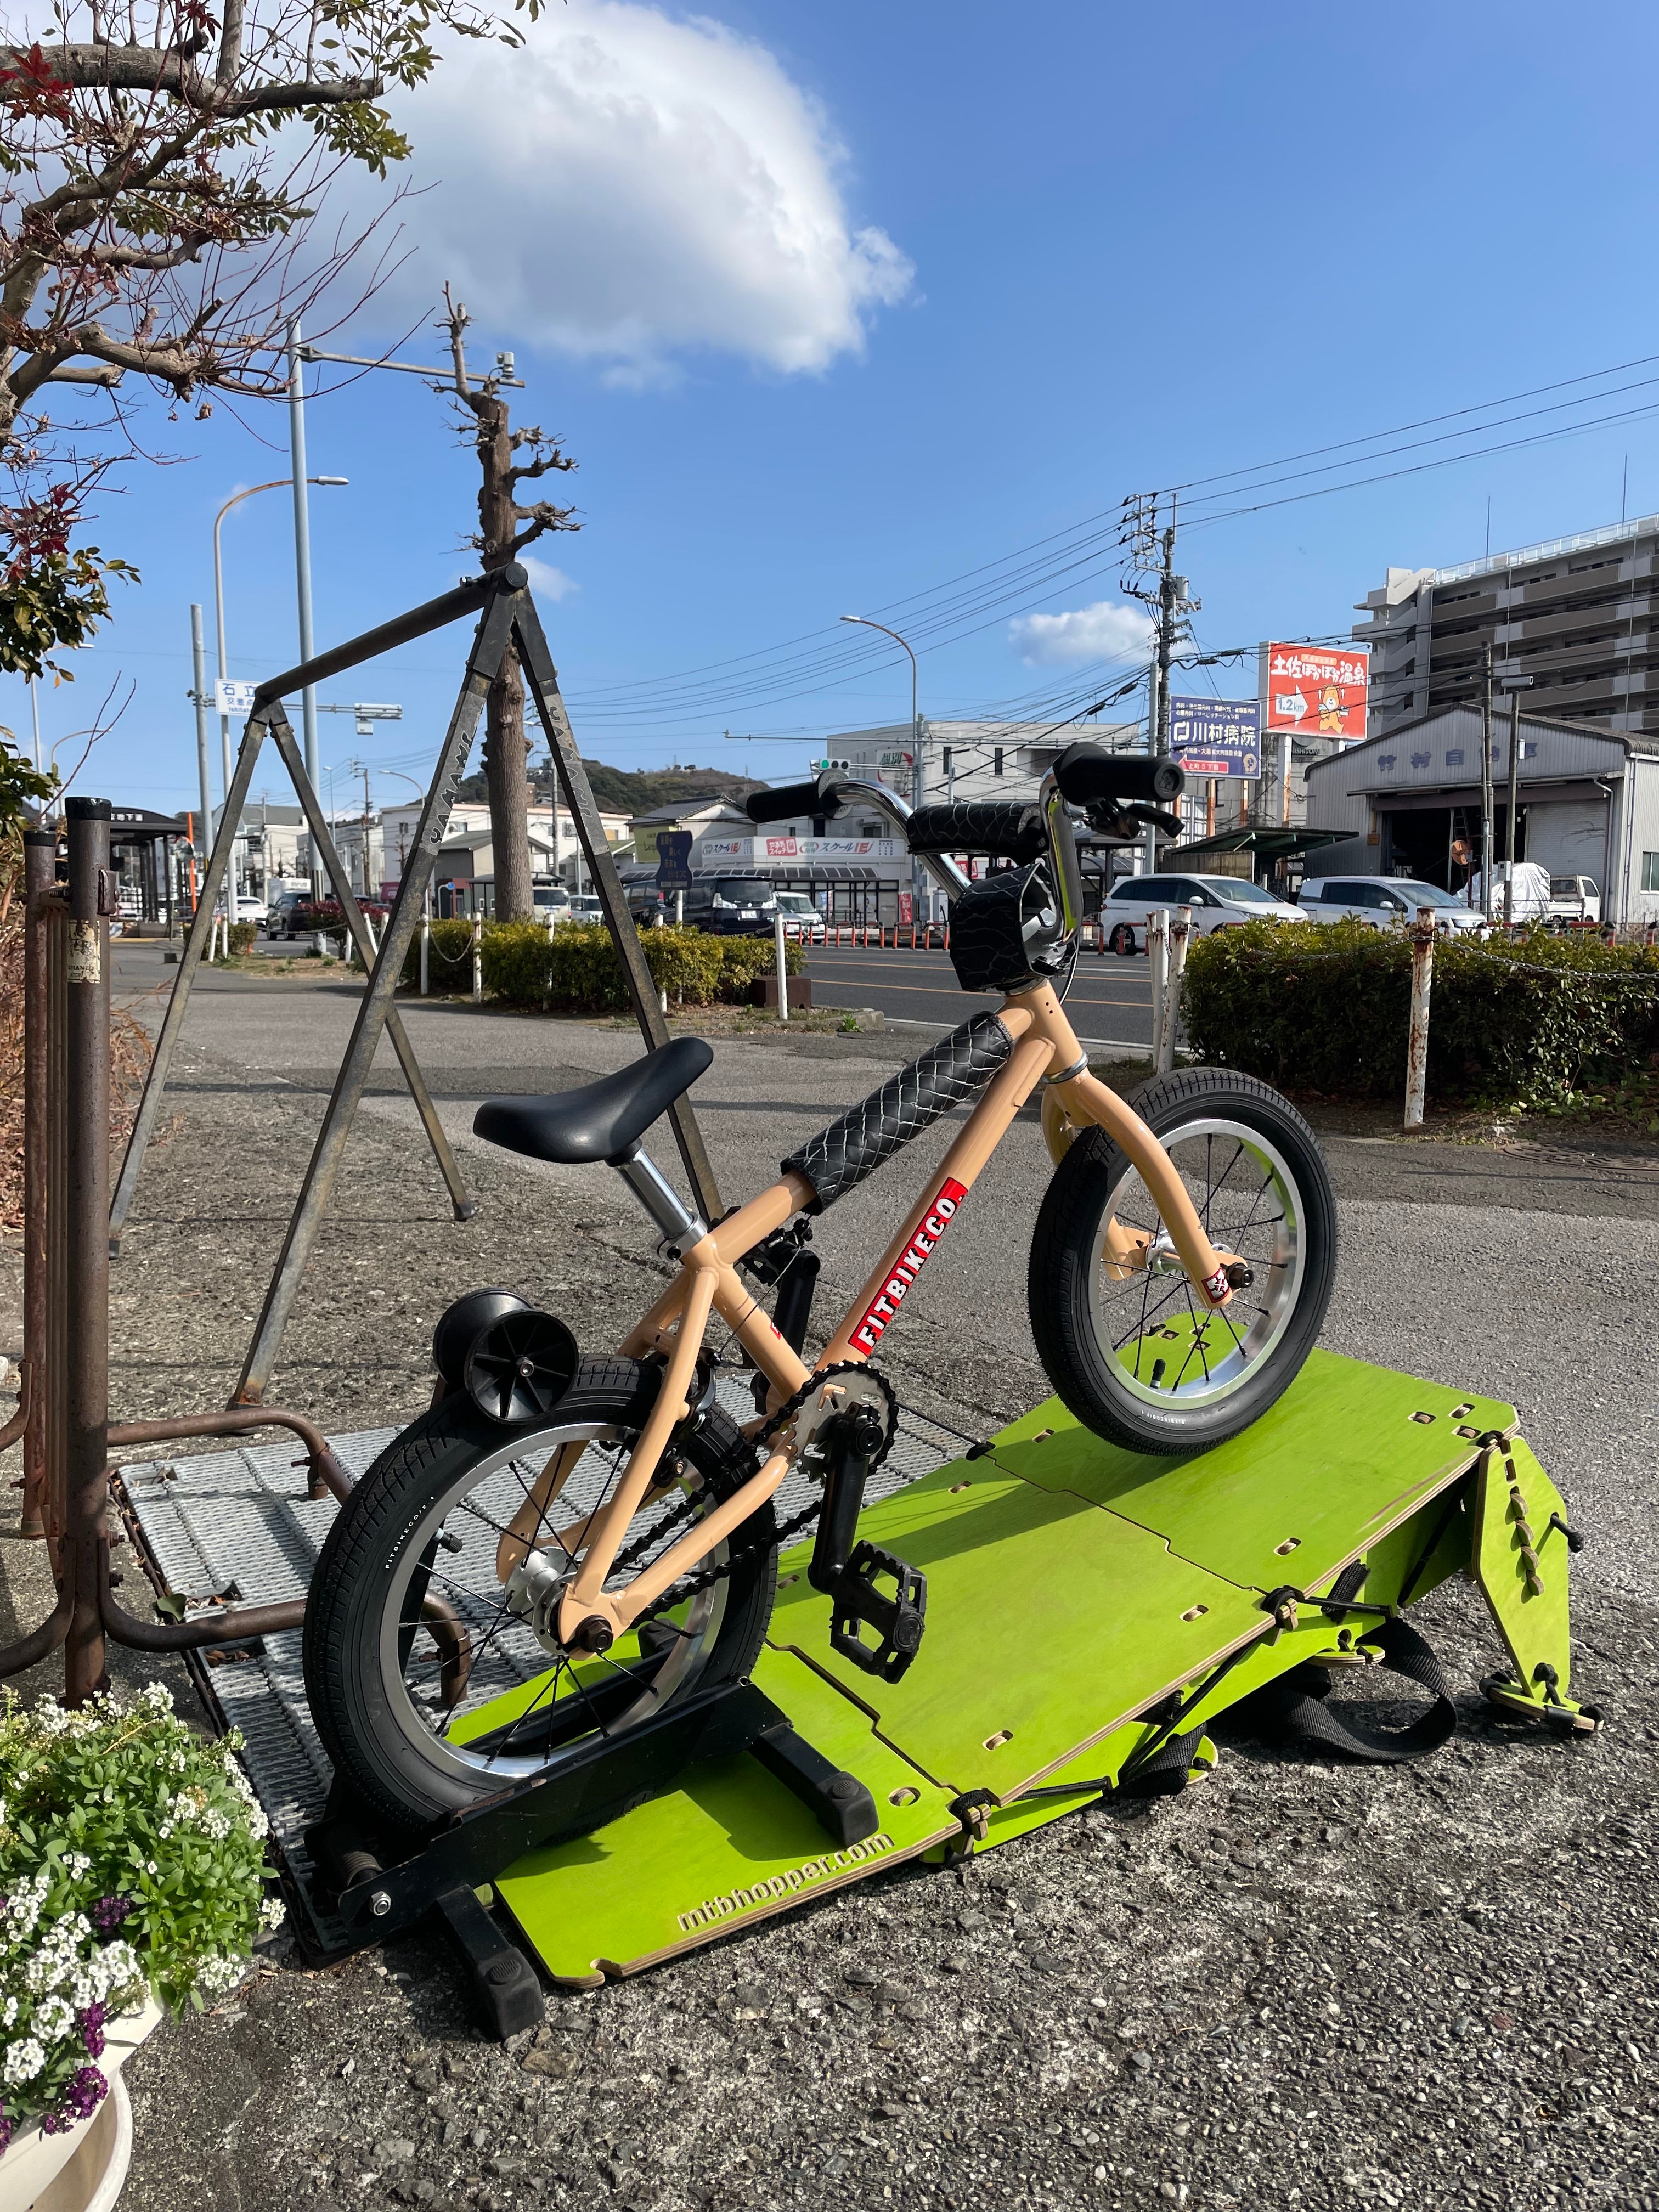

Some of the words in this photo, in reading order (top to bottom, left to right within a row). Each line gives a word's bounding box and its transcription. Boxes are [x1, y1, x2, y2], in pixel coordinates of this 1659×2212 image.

[222, 682, 256, 697] 石立
[1278, 699, 1305, 712] 1.2km
[1192, 721, 1256, 747] 川村病院
[857, 1194, 966, 1347] FITBIKECO.
[676, 1833, 895, 1931] mtbhopper.com
